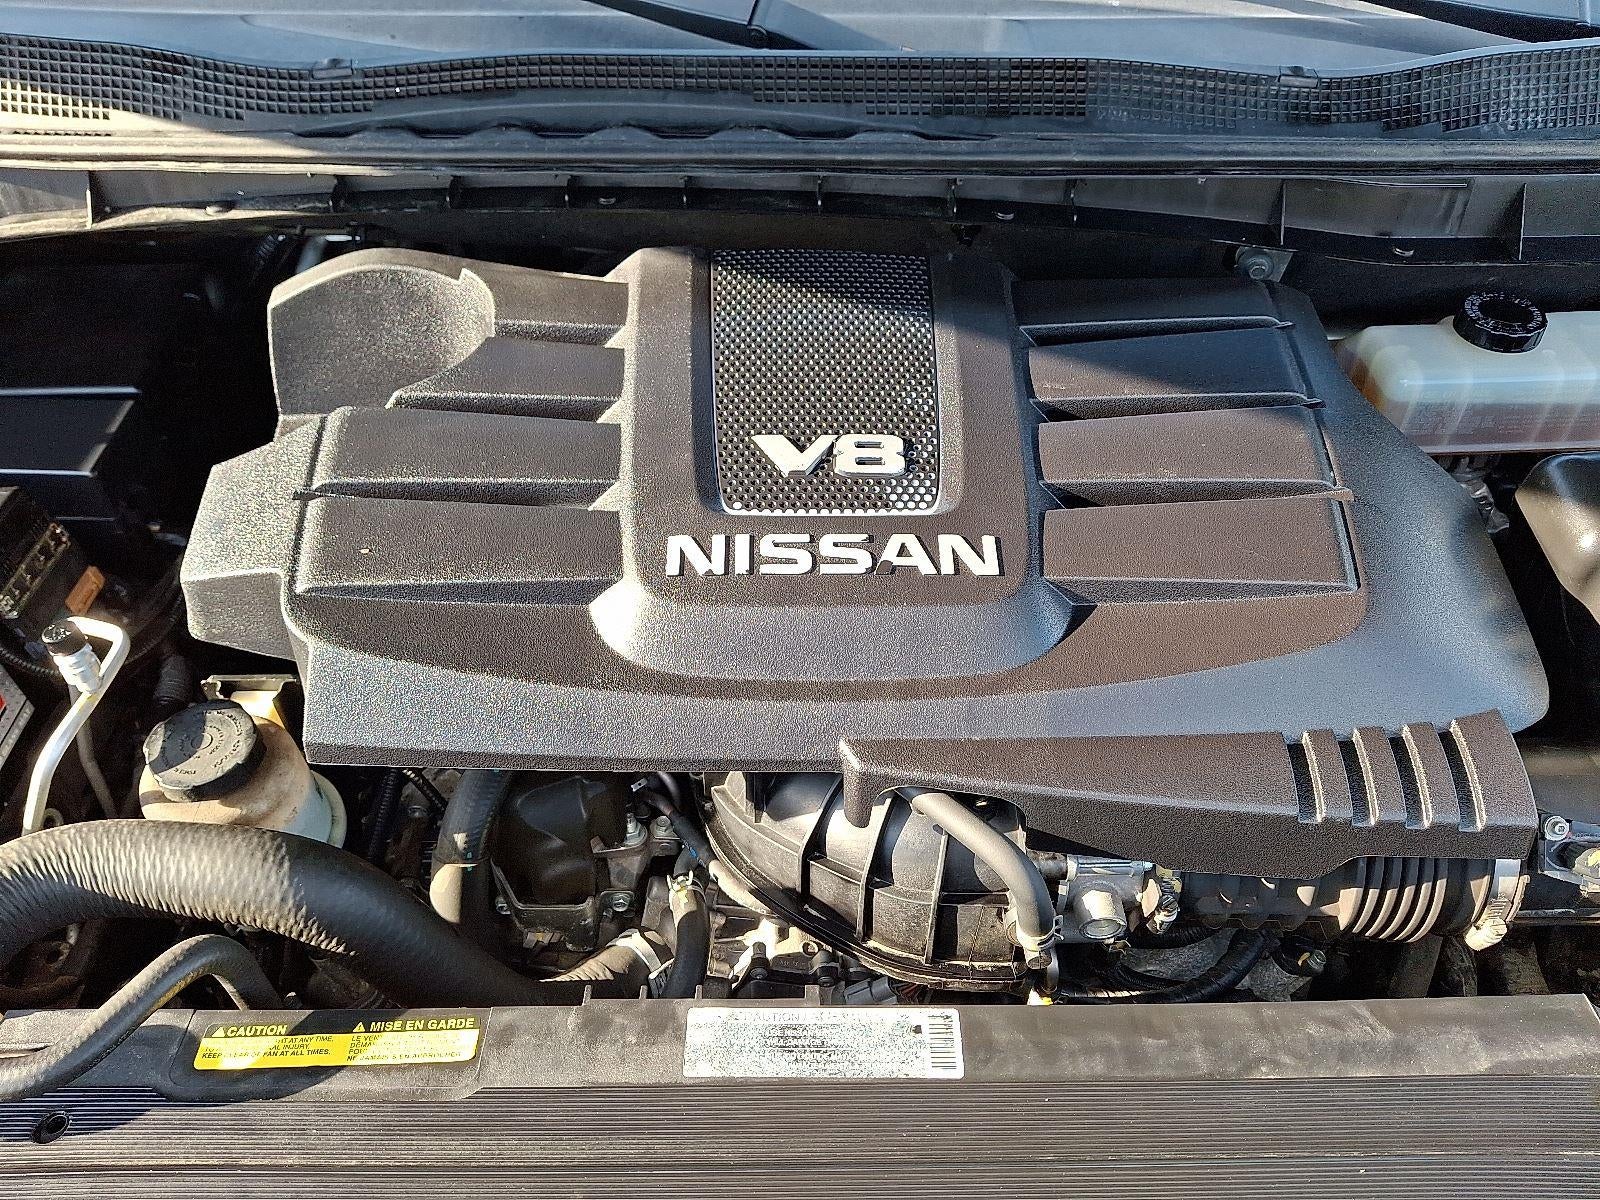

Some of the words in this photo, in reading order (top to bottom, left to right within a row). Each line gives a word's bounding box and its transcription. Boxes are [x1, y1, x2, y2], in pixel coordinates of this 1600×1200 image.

[751, 434, 906, 477] V8
[665, 533, 1003, 577] NISSAN
[226, 1024, 288, 1037] CAUTION
[369, 1020, 402, 1032] MISE
[405, 1020, 424, 1031] EN
[427, 1017, 475, 1030] GARDE
